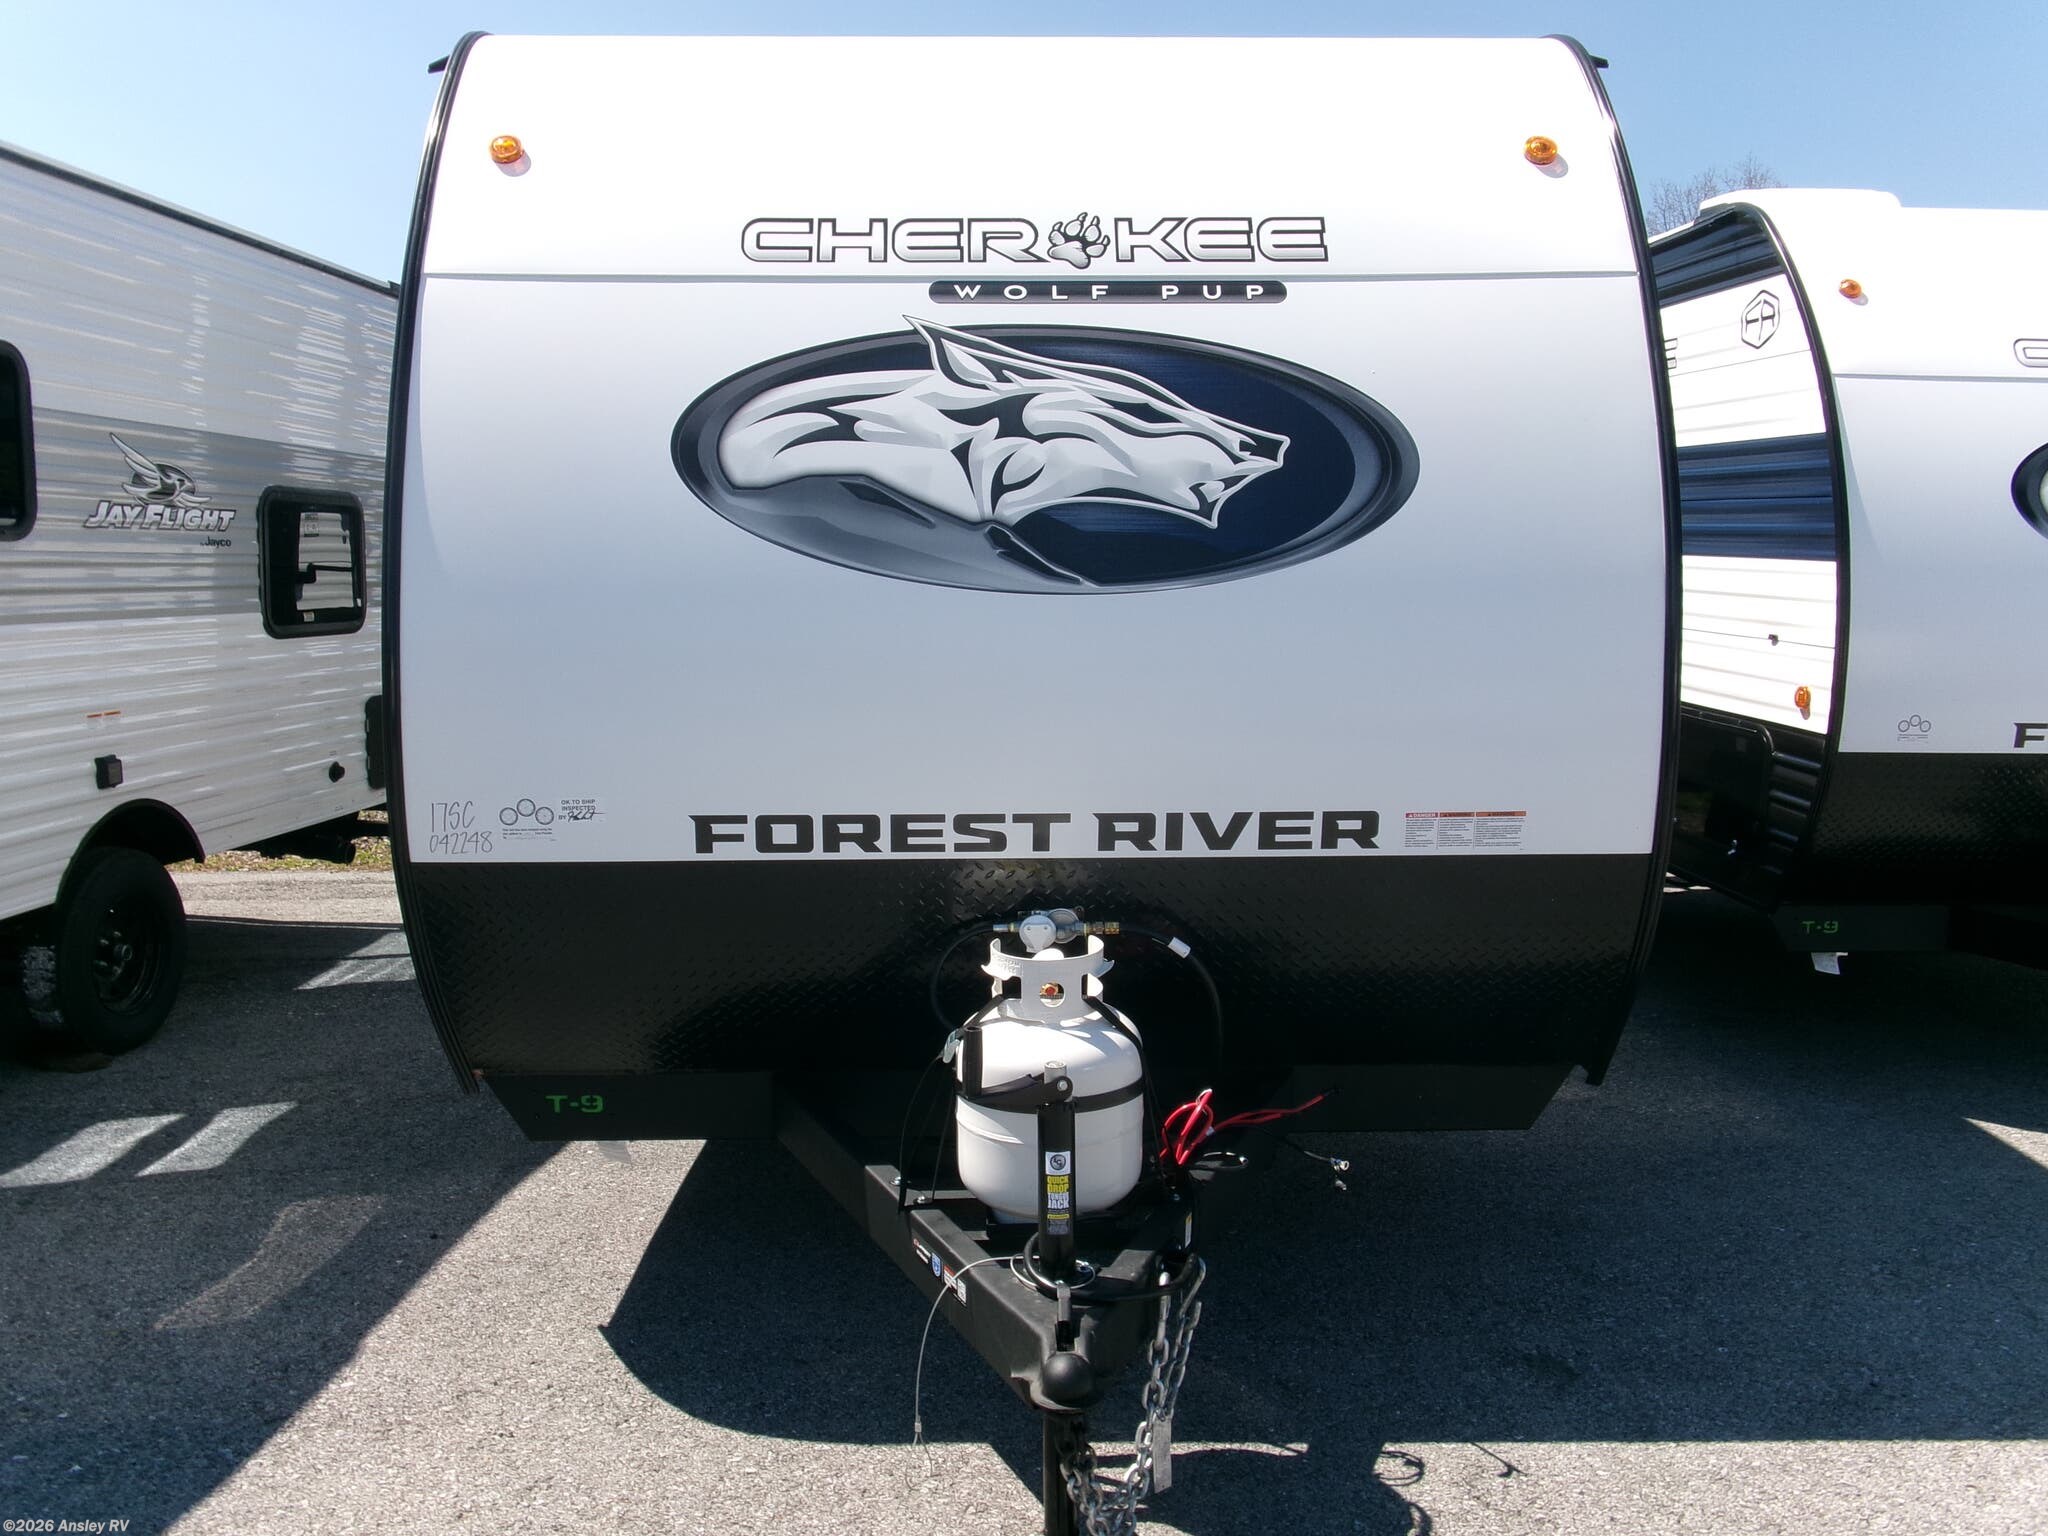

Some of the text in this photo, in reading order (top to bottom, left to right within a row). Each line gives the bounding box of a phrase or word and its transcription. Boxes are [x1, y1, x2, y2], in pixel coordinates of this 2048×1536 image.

[953, 283, 1265, 301] WOLF PUP
[83, 500, 237, 532] JAY FLIGHT
[204, 536, 232, 549] Jayco
[688, 812, 1072, 855] FOREST
[1093, 810, 1381, 852] RIVER
[545, 1095, 604, 1113] T-9
[1047, 1200, 1070, 1210] JACK
